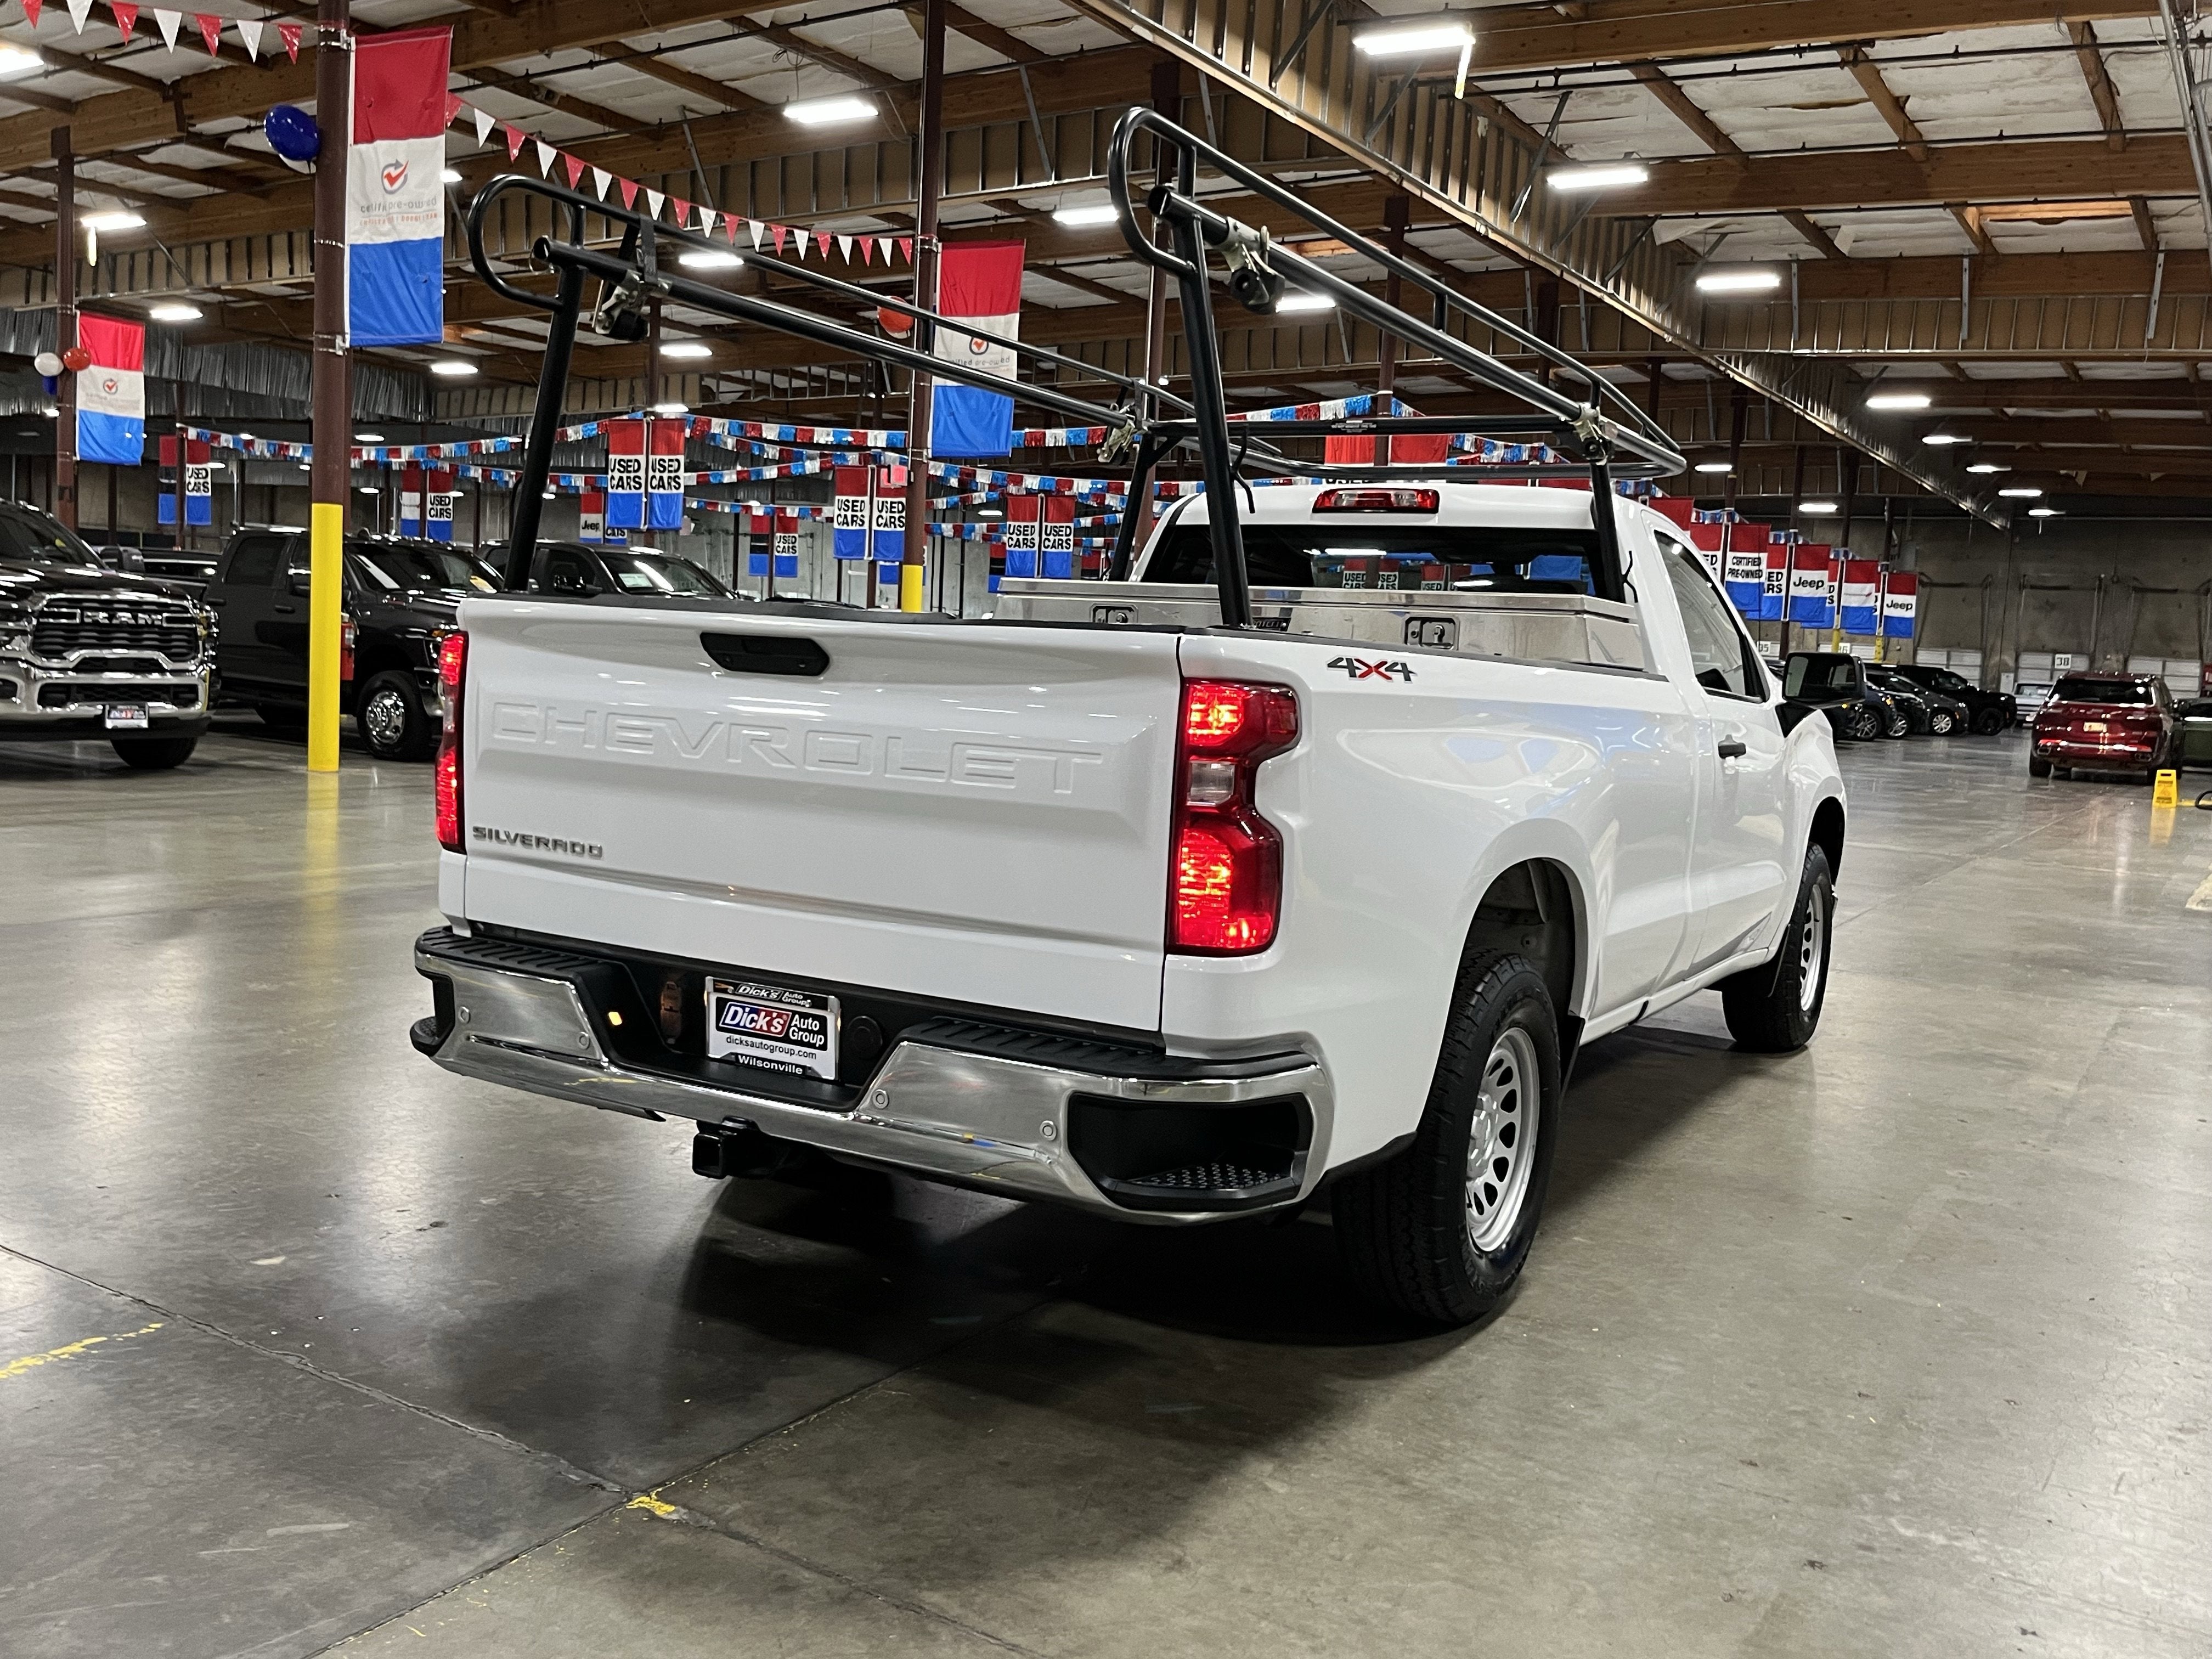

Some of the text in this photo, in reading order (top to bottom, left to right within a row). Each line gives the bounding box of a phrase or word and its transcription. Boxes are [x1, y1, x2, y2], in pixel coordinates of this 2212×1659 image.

[388, 195, 437, 209] pre-owed
[610, 458, 641, 473] USED
[651, 458, 681, 473] USED
[187, 467, 208, 479] USED
[610, 475, 642, 490] CARS
[650, 475, 681, 490] CARS
[430, 494, 451, 506] USED
[838, 499, 865, 512] USED
[428, 507, 452, 518] CARS
[877, 500, 904, 514] USED
[582, 521, 600, 532] Jeep
[837, 514, 865, 527] CARS
[876, 515, 905, 528] CARS
[1008, 524, 1035, 536] USED
[1044, 525, 1072, 537] USED
[776, 534, 797, 544] USED
[1008, 537, 1035, 549] CARS
[1043, 538, 1071, 550] CARS
[1732, 556, 1762, 566] CERTIFIED
[1728, 568, 1763, 579] PRE-OWNED
[1768, 571, 1784, 582] ED
[1767, 583, 1782, 594] RS
[1793, 577, 1825, 590] Jeep
[1886, 600, 1914, 612] Jeep
[83, 612, 162, 624] RAM
[2056, 657, 2070, 666] 38
[492, 702, 1103, 794] CHEVROLET
[473, 826, 603, 859] SILVERADO
[738, 984, 782, 1000] Dick's
[783, 991, 804, 1000] Auto
[782, 995, 810, 1006] Group
[724, 1005, 785, 1033] Dick's
[791, 1014, 820, 1031] Auto
[789, 1027, 825, 1047] Group
[726, 1035, 816, 1060] dicksautogroup.com
[738, 1054, 803, 1074] Wilsonville
